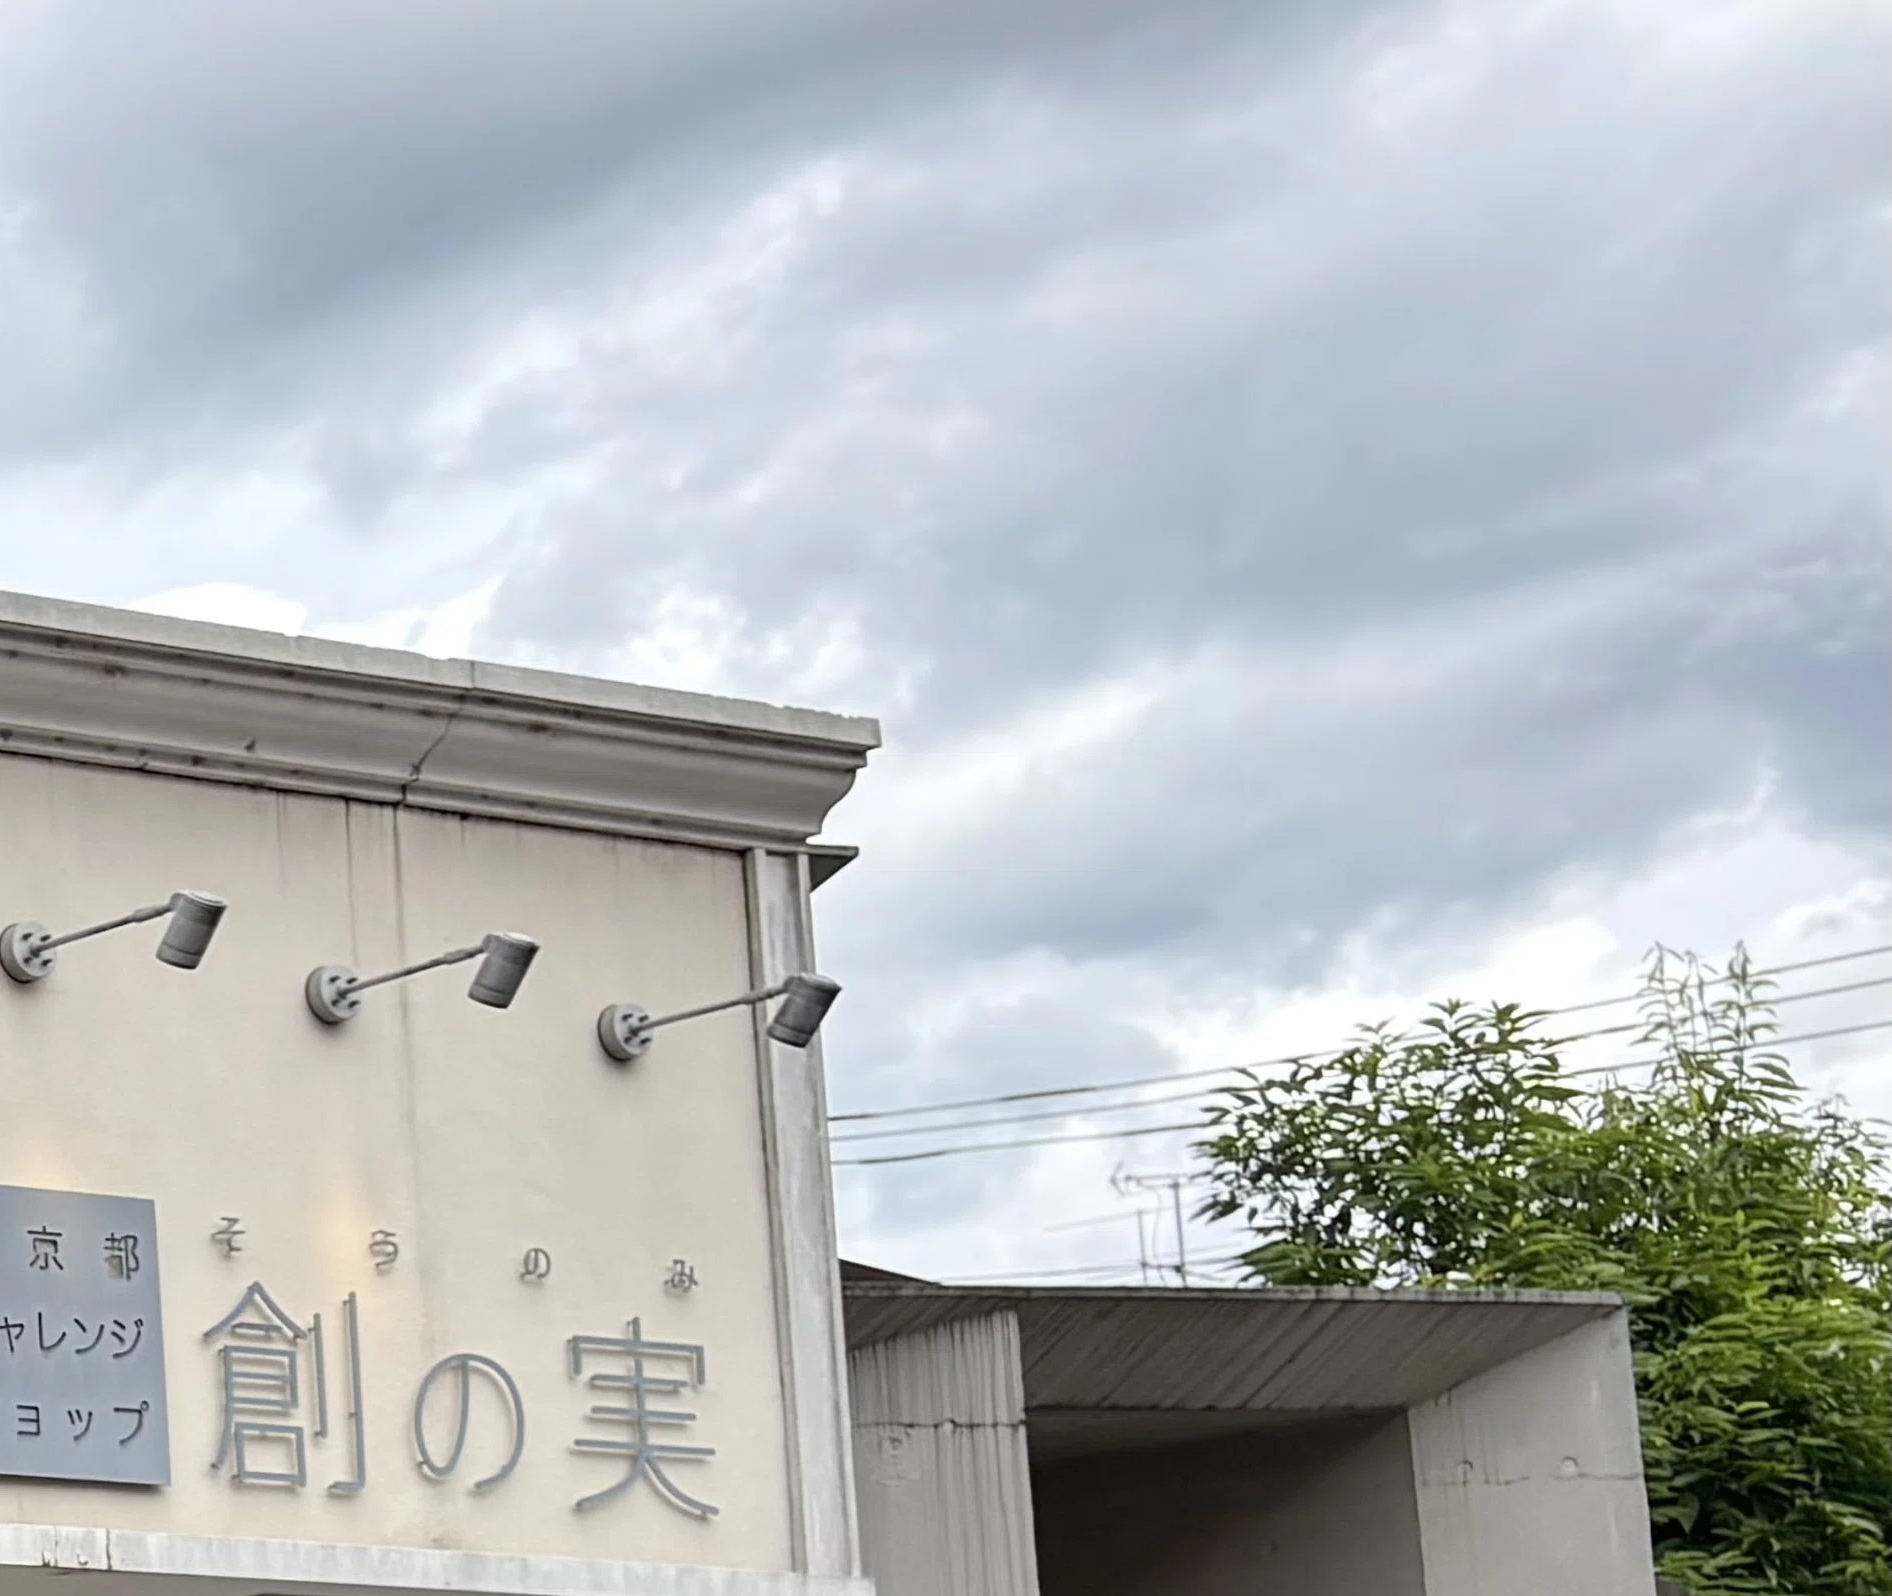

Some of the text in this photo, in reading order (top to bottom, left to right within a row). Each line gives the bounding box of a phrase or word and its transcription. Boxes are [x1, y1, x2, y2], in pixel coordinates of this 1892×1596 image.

[211, 1216, 699, 1294] そうのみ
[202, 1280, 721, 1520] 創の実
